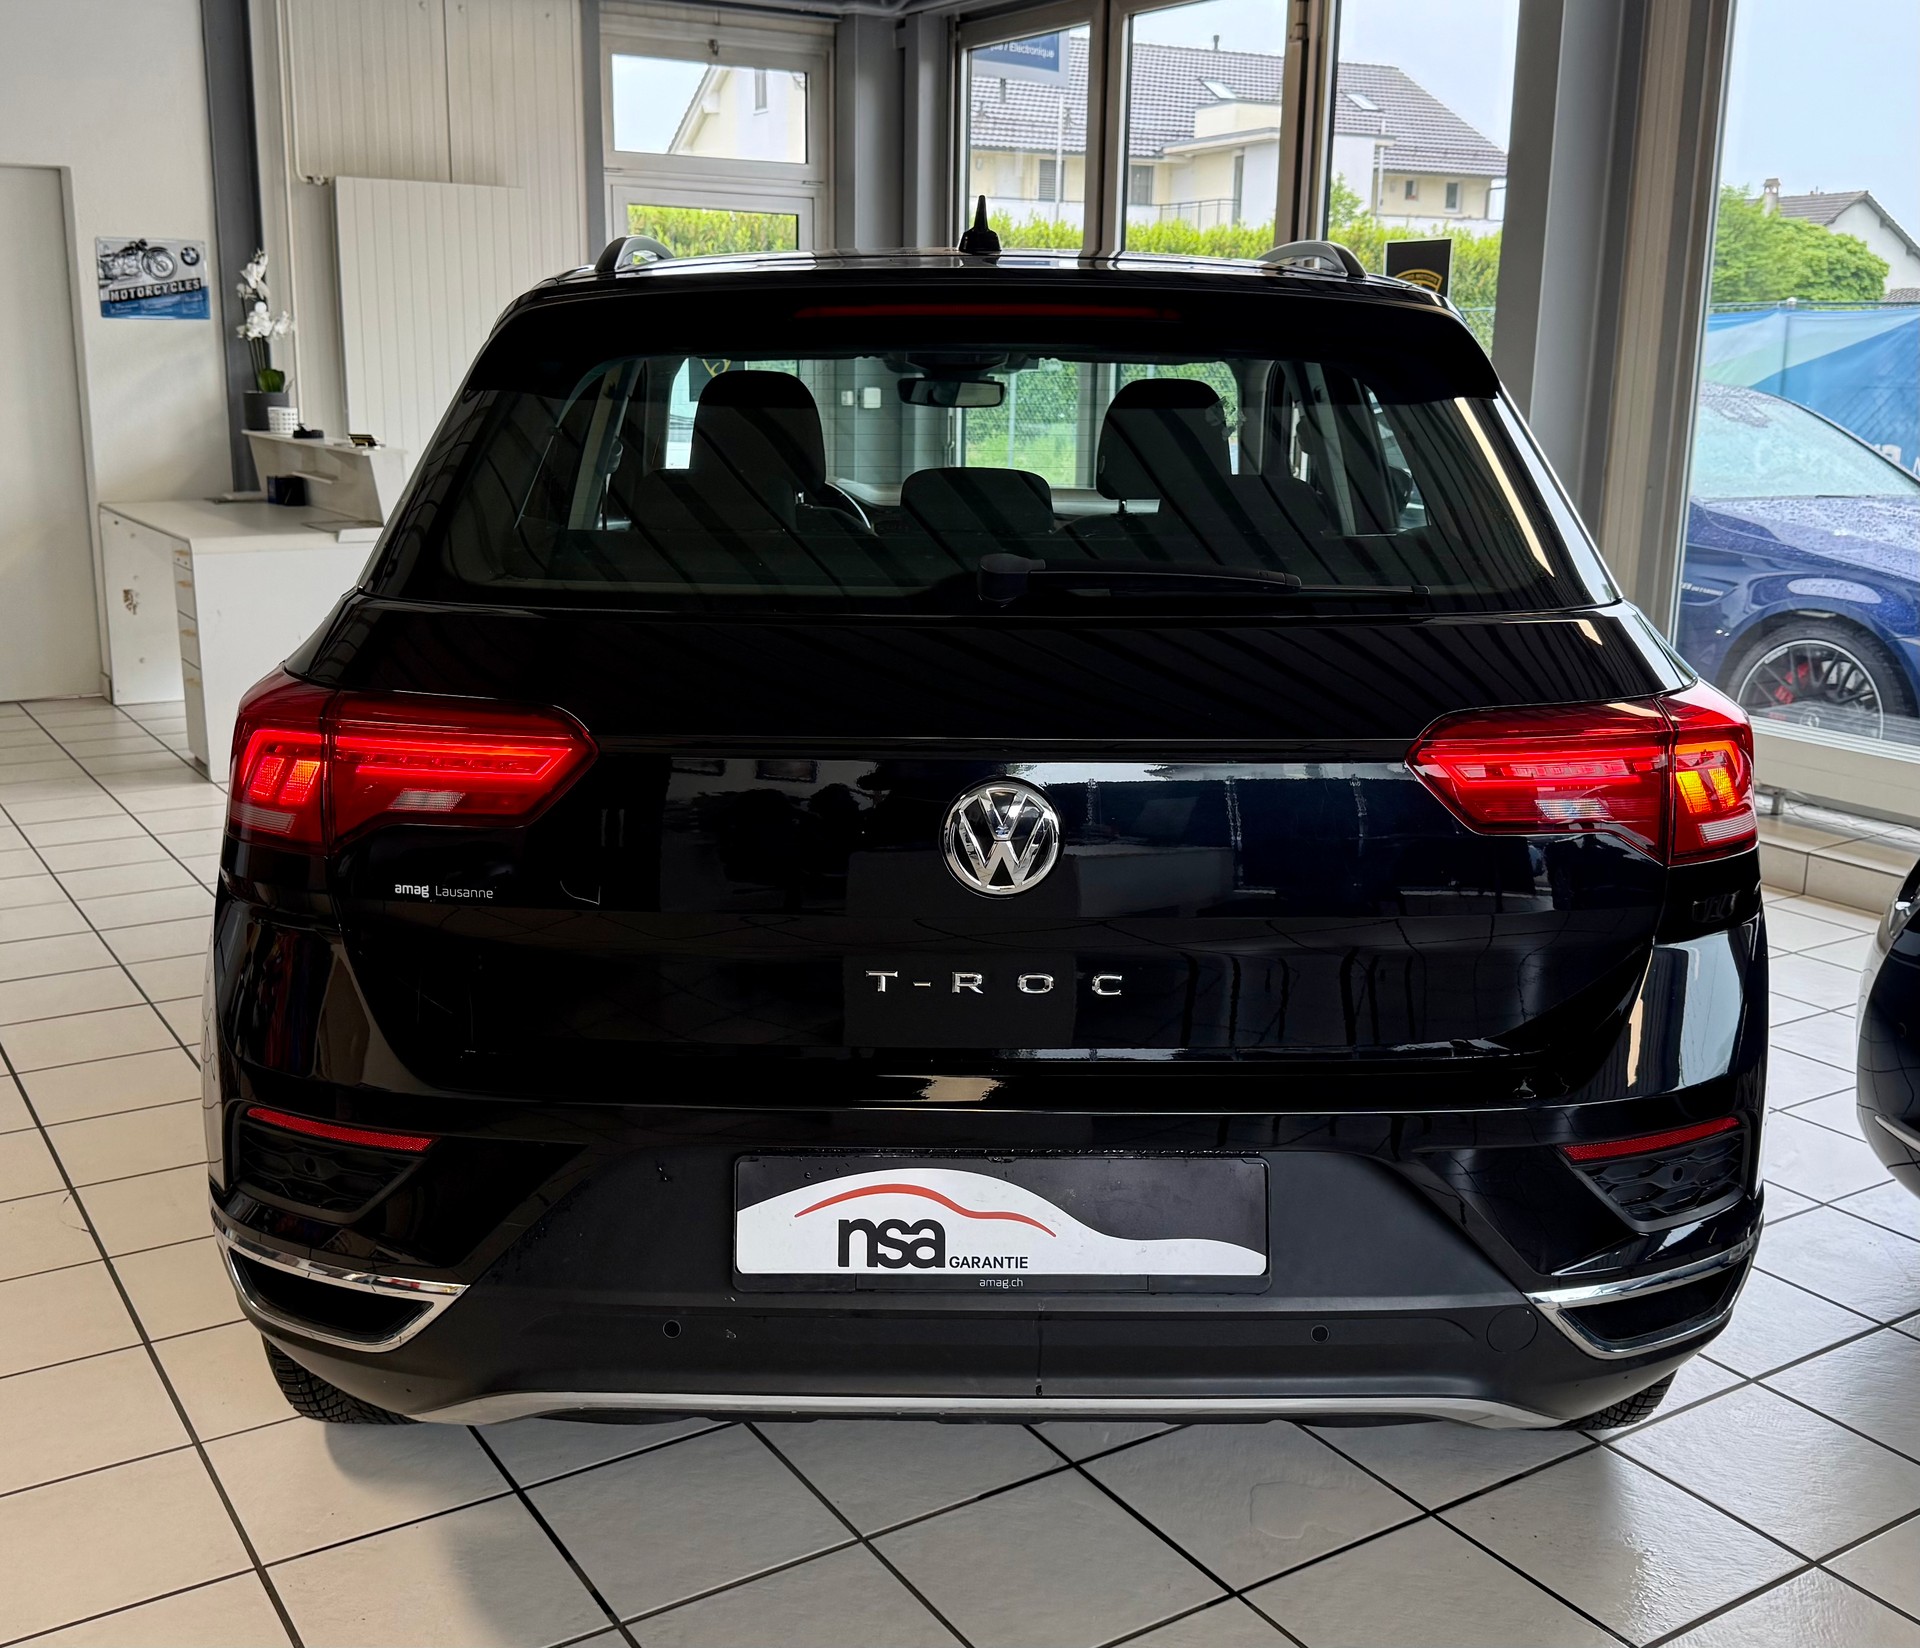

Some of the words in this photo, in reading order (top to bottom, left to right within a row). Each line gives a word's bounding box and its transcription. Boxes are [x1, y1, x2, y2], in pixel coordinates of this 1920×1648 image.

[110, 279, 201, 302] MOTORCYCLES
[394, 884, 429, 898] amag
[435, 885, 494, 899] Lausanne
[865, 970, 1124, 996] T-ROC
[838, 1218, 946, 1269] nsa
[949, 1256, 1029, 1269] GARANTIE
[979, 1277, 1024, 1289] amag.ch
